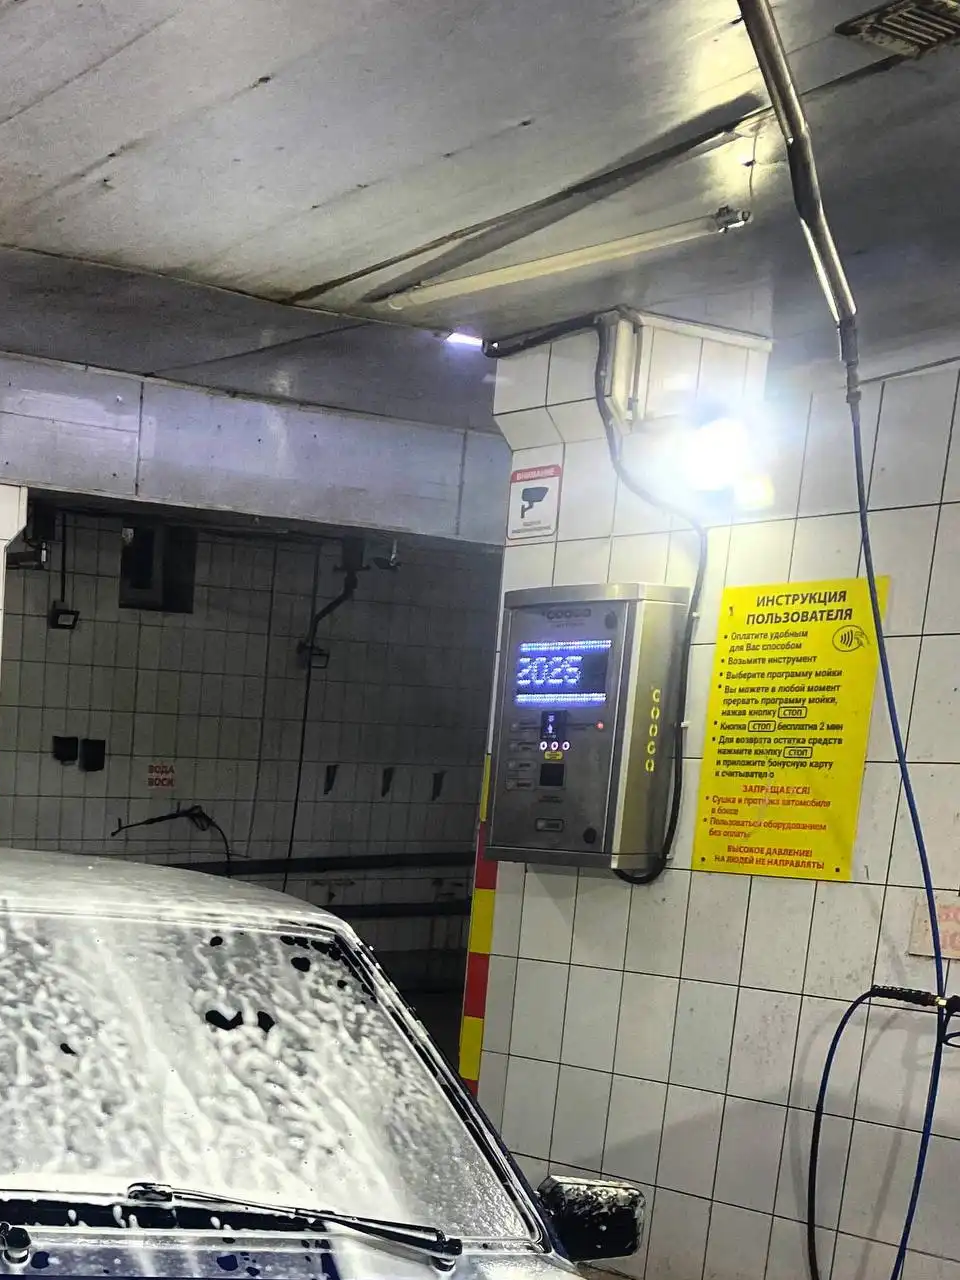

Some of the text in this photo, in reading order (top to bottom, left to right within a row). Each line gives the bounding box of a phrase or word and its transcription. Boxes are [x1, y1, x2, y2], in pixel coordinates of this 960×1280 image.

[756, 590, 847, 607] ИНСТРУКЦИЯ
[746, 608, 853, 625] ПОЛЬЗОВАТЕЛЯ
[731, 629, 808, 642] Оплатите удобным
[729, 642, 802, 653] для Вас способом
[728, 655, 817, 666] Возьмите инструмент
[517, 655, 583, 685] 2025
[726, 667, 843, 681] Выберите программу мойки
[724, 685, 736, 693] Вы
[778, 684, 805, 693] любой
[807, 684, 841, 692] момент
[723, 697, 759, 706] прервать
[761, 696, 806, 706] программу
[749, 709, 777, 717] кнопку
[782, 709, 803, 717] СТОП
[720, 722, 746, 730] Кнопка
[752, 722, 772, 730] СТОП
[819, 722, 825, 730] 2
[826, 723, 843, 731] мин
[719, 736, 734, 745] Для
[736, 737, 771, 745] возврата
[808, 737, 843, 746] средств
[717, 748, 809, 758] нажмите кнопку СТОП
[148, 764, 175, 774] ВОДА
[722, 759, 766, 767] приложите
[768, 758, 807, 769] бонусную
[809, 761, 833, 770] карту
[148, 777, 175, 787] ВОСК
[712, 795, 736, 804] Сушка
[781, 797, 831, 807] автомобиля
[709, 817, 827, 831] Пользоваться оборудованием
[708, 828, 721, 837] без
[727, 845, 765, 854] ВЫСОКОЕ
[726, 855, 754, 865] ЛЮДЕЙ
